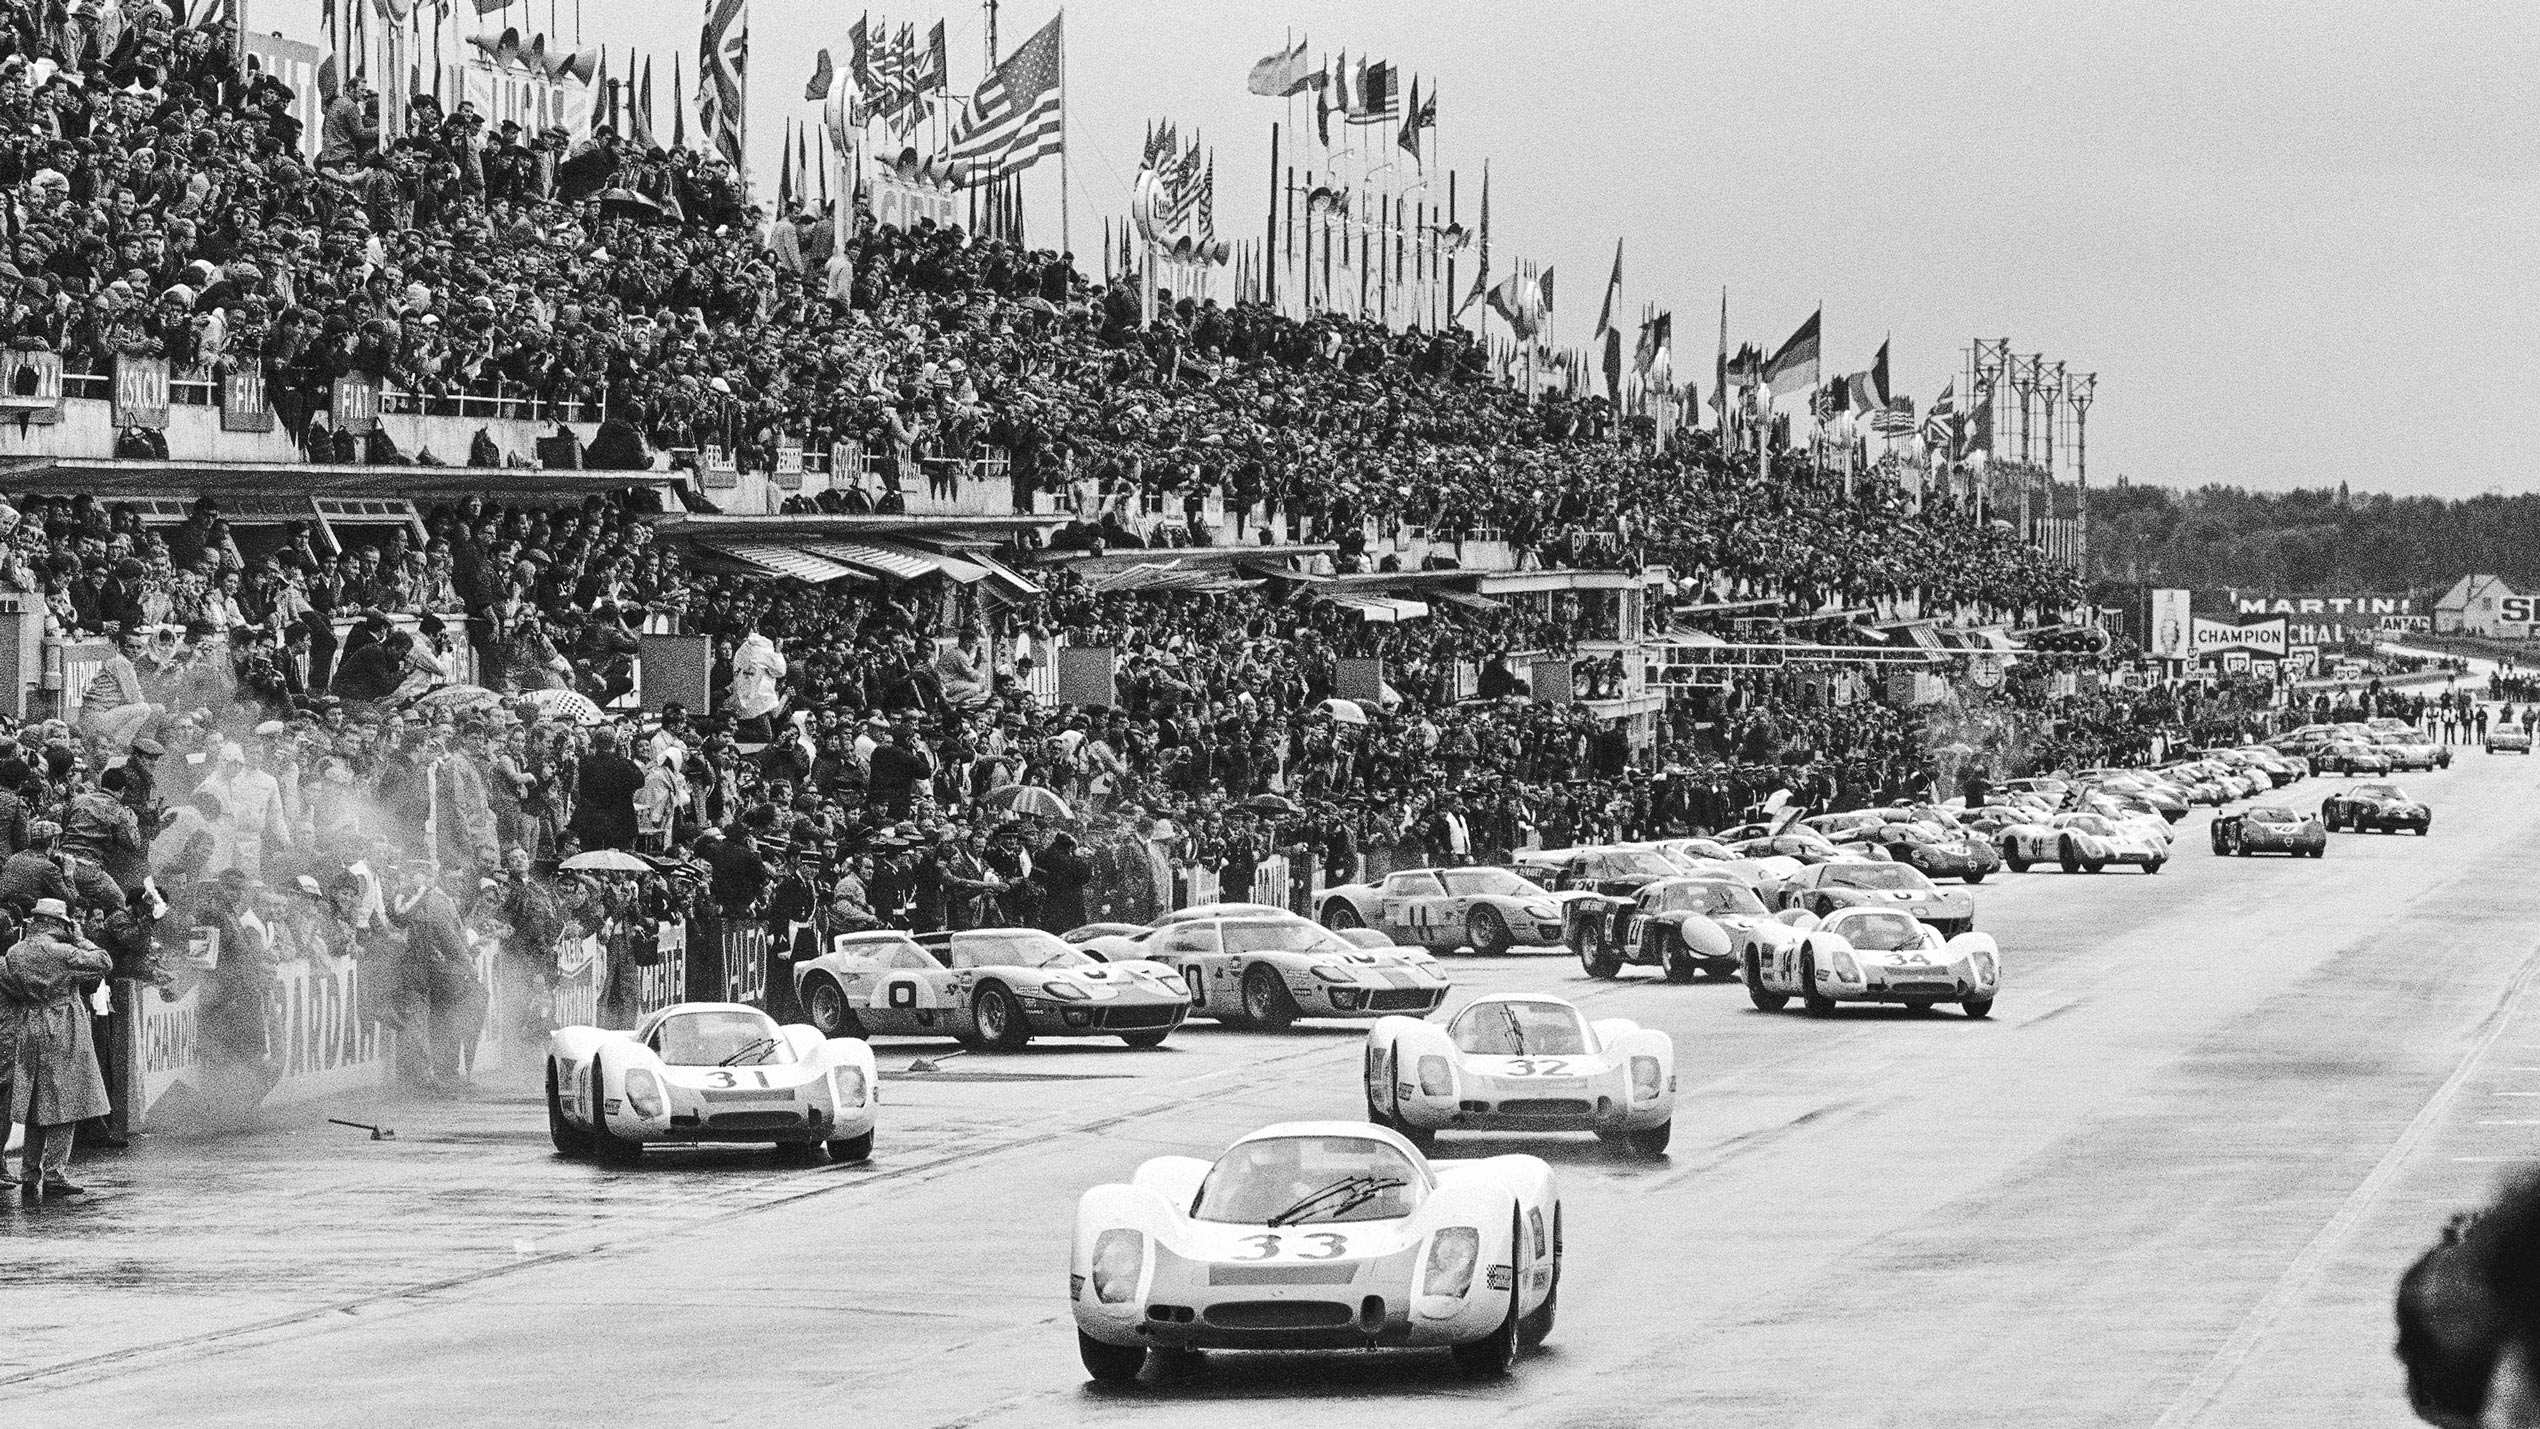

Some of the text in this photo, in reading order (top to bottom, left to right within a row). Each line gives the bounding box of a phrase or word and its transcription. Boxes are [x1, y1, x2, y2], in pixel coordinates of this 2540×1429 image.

[235, 376, 266, 413] FIAT
[342, 383, 370, 419] FIAT
[2240, 598, 2410, 614] MARTINI
[2502, 598, 2540, 622] S
[2198, 629, 2281, 644] CHAMPION
[722, 927, 767, 1004] VALEO
[1884, 953, 1932, 966] 34
[1505, 1058, 1574, 1078] 32
[706, 1069, 771, 1090] 31
[1231, 1232, 1348, 1261] 33
